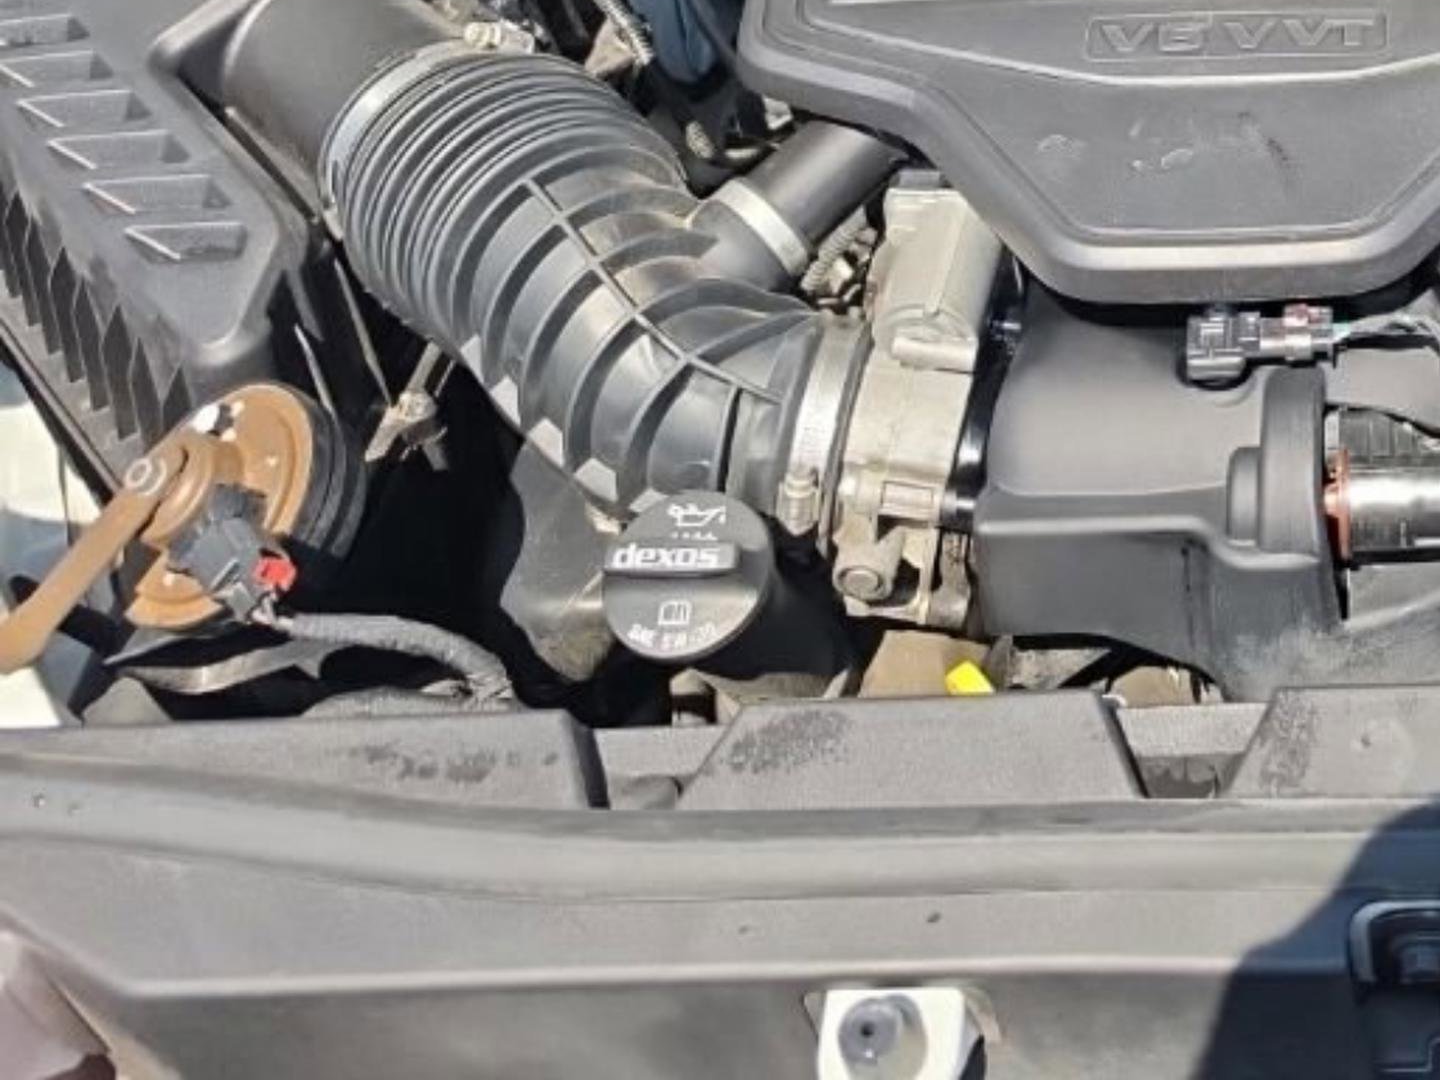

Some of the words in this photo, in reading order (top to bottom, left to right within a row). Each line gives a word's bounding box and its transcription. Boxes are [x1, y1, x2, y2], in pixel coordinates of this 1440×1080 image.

[1101, 21, 1207, 52] V6
[1223, 19, 1375, 49] VVT
[612, 542, 721, 569] dexos
